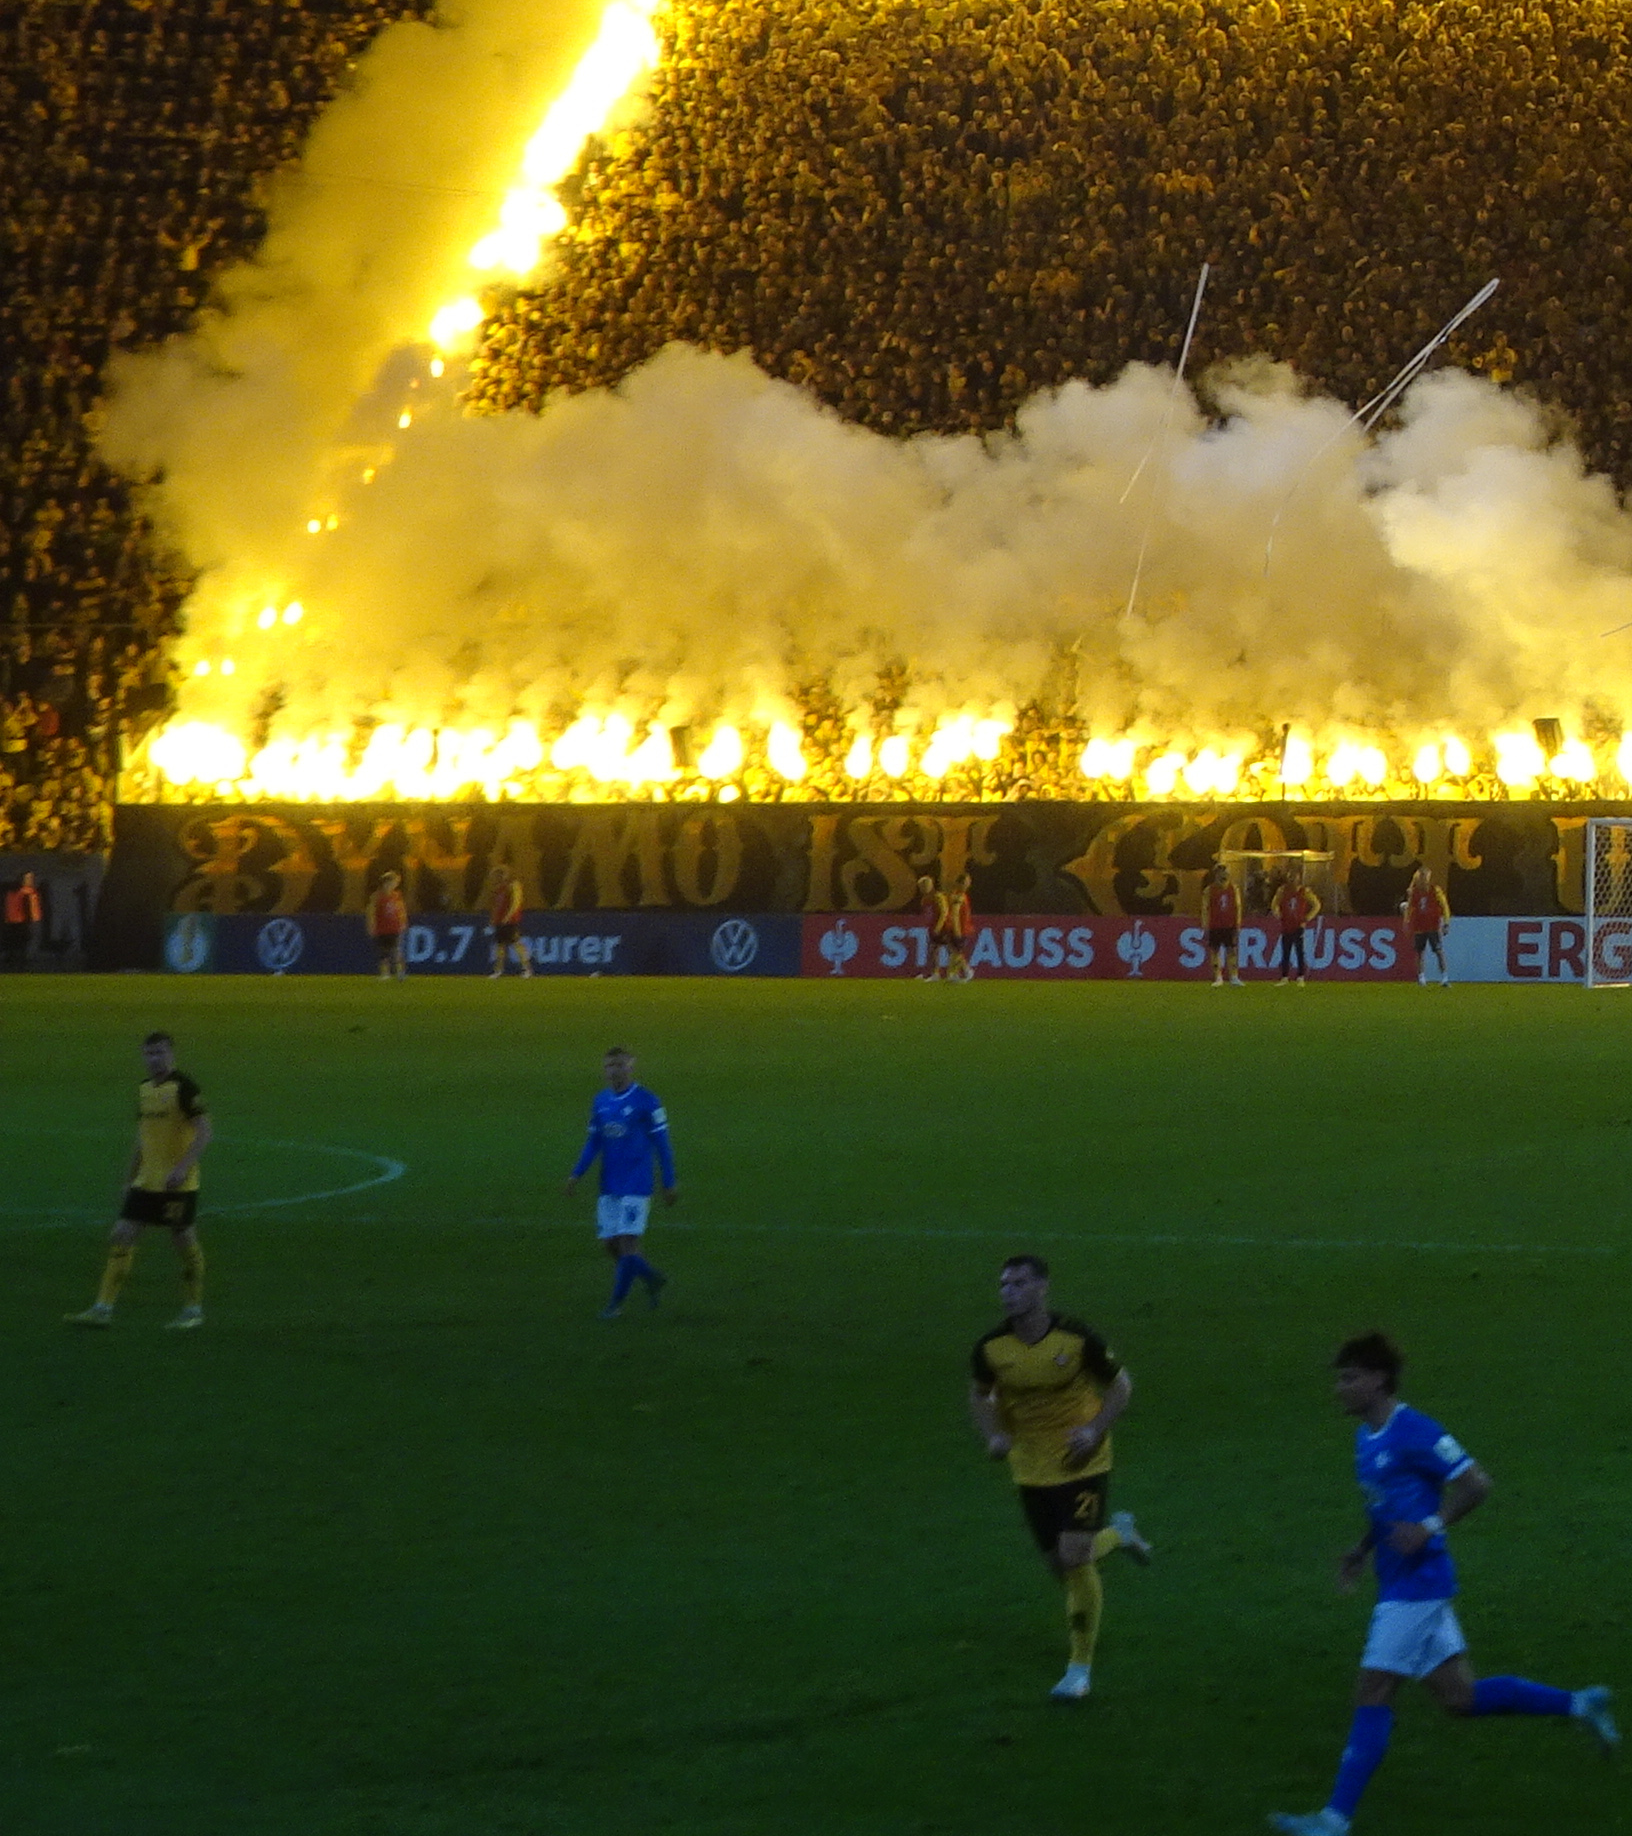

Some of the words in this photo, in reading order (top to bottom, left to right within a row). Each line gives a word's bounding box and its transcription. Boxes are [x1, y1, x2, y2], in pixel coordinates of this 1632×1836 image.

[172, 813, 744, 914] DYNAMO
[805, 813, 999, 913] IST
[879, 926, 1095, 969] STAUSS
[1178, 926, 1397, 970] SRAUSS
